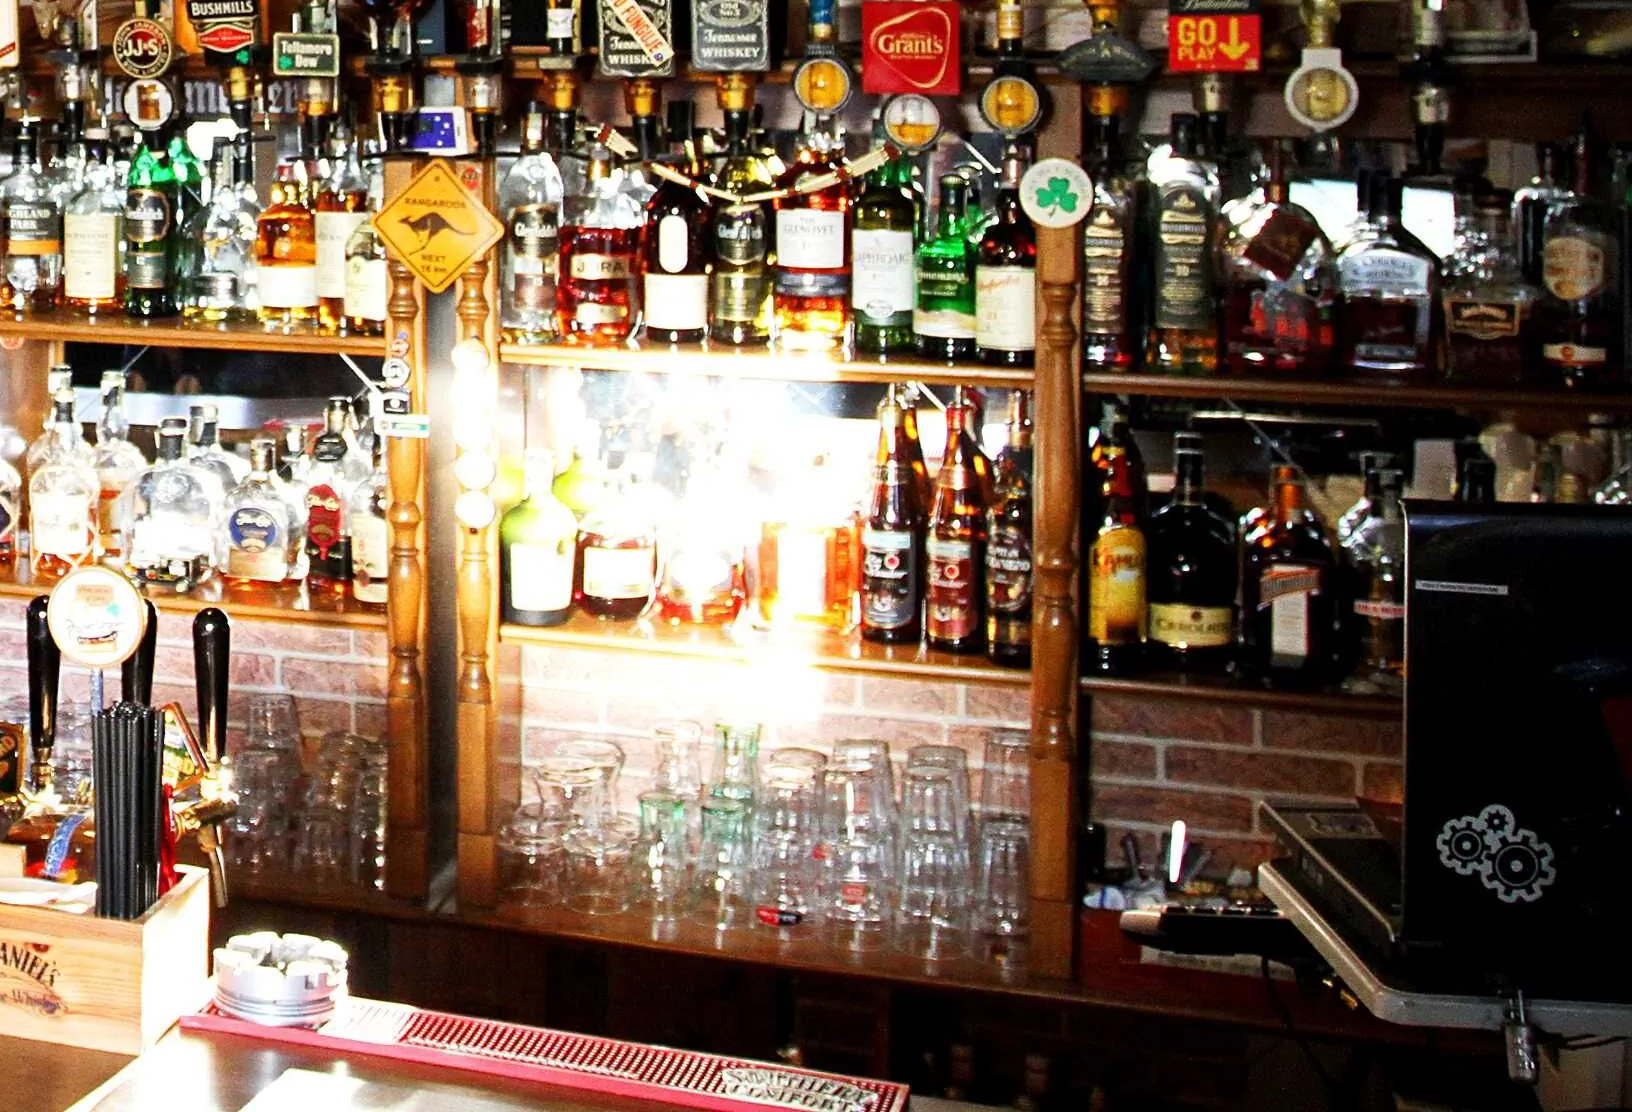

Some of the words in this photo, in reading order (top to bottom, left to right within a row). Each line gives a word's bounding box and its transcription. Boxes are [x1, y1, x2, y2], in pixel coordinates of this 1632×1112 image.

[191, 0, 255, 17] BUSHMILLS
[703, 28, 758, 43] Tennessee
[1178, 17, 1217, 46] GO
[280, 39, 333, 56] Tullamore
[878, 31, 945, 55] Grant's
[701, 46, 761, 58] WHISKEY
[1177, 46, 1217, 61] PLAY
[294, 53, 319, 69] Dew
[576, 261, 626, 274] JRA
